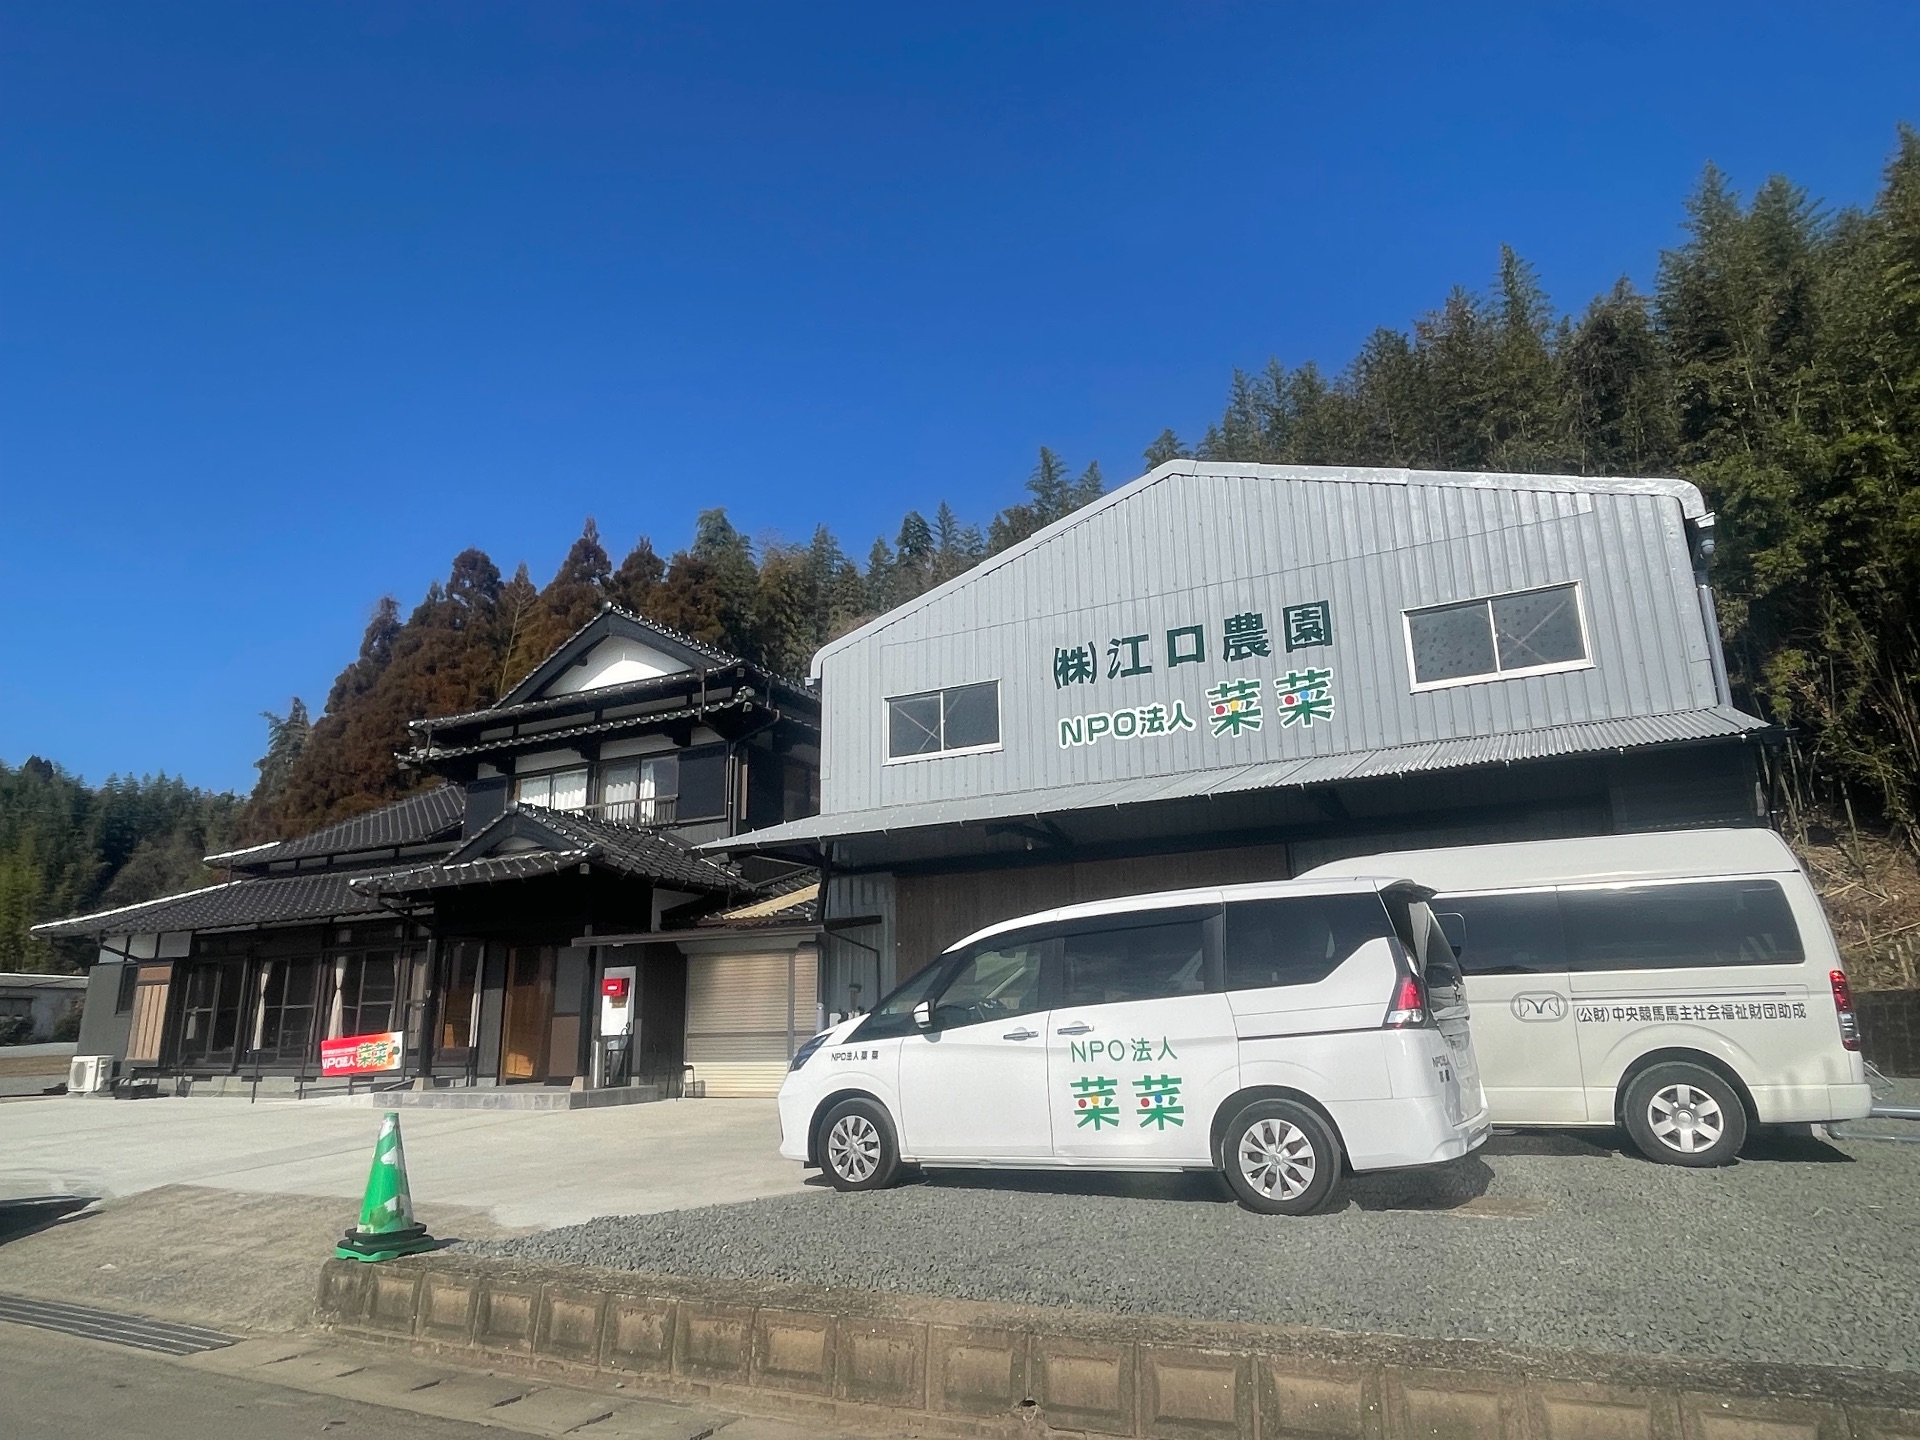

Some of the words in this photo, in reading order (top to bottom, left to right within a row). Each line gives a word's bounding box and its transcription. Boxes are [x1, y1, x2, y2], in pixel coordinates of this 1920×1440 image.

[1059, 702, 1195, 747] NPO法人
[1206, 667, 1335, 738] 菜菜
[1070, 1035, 1178, 1063] NPO法人
[1069, 1073, 1185, 1131] 菜菜
